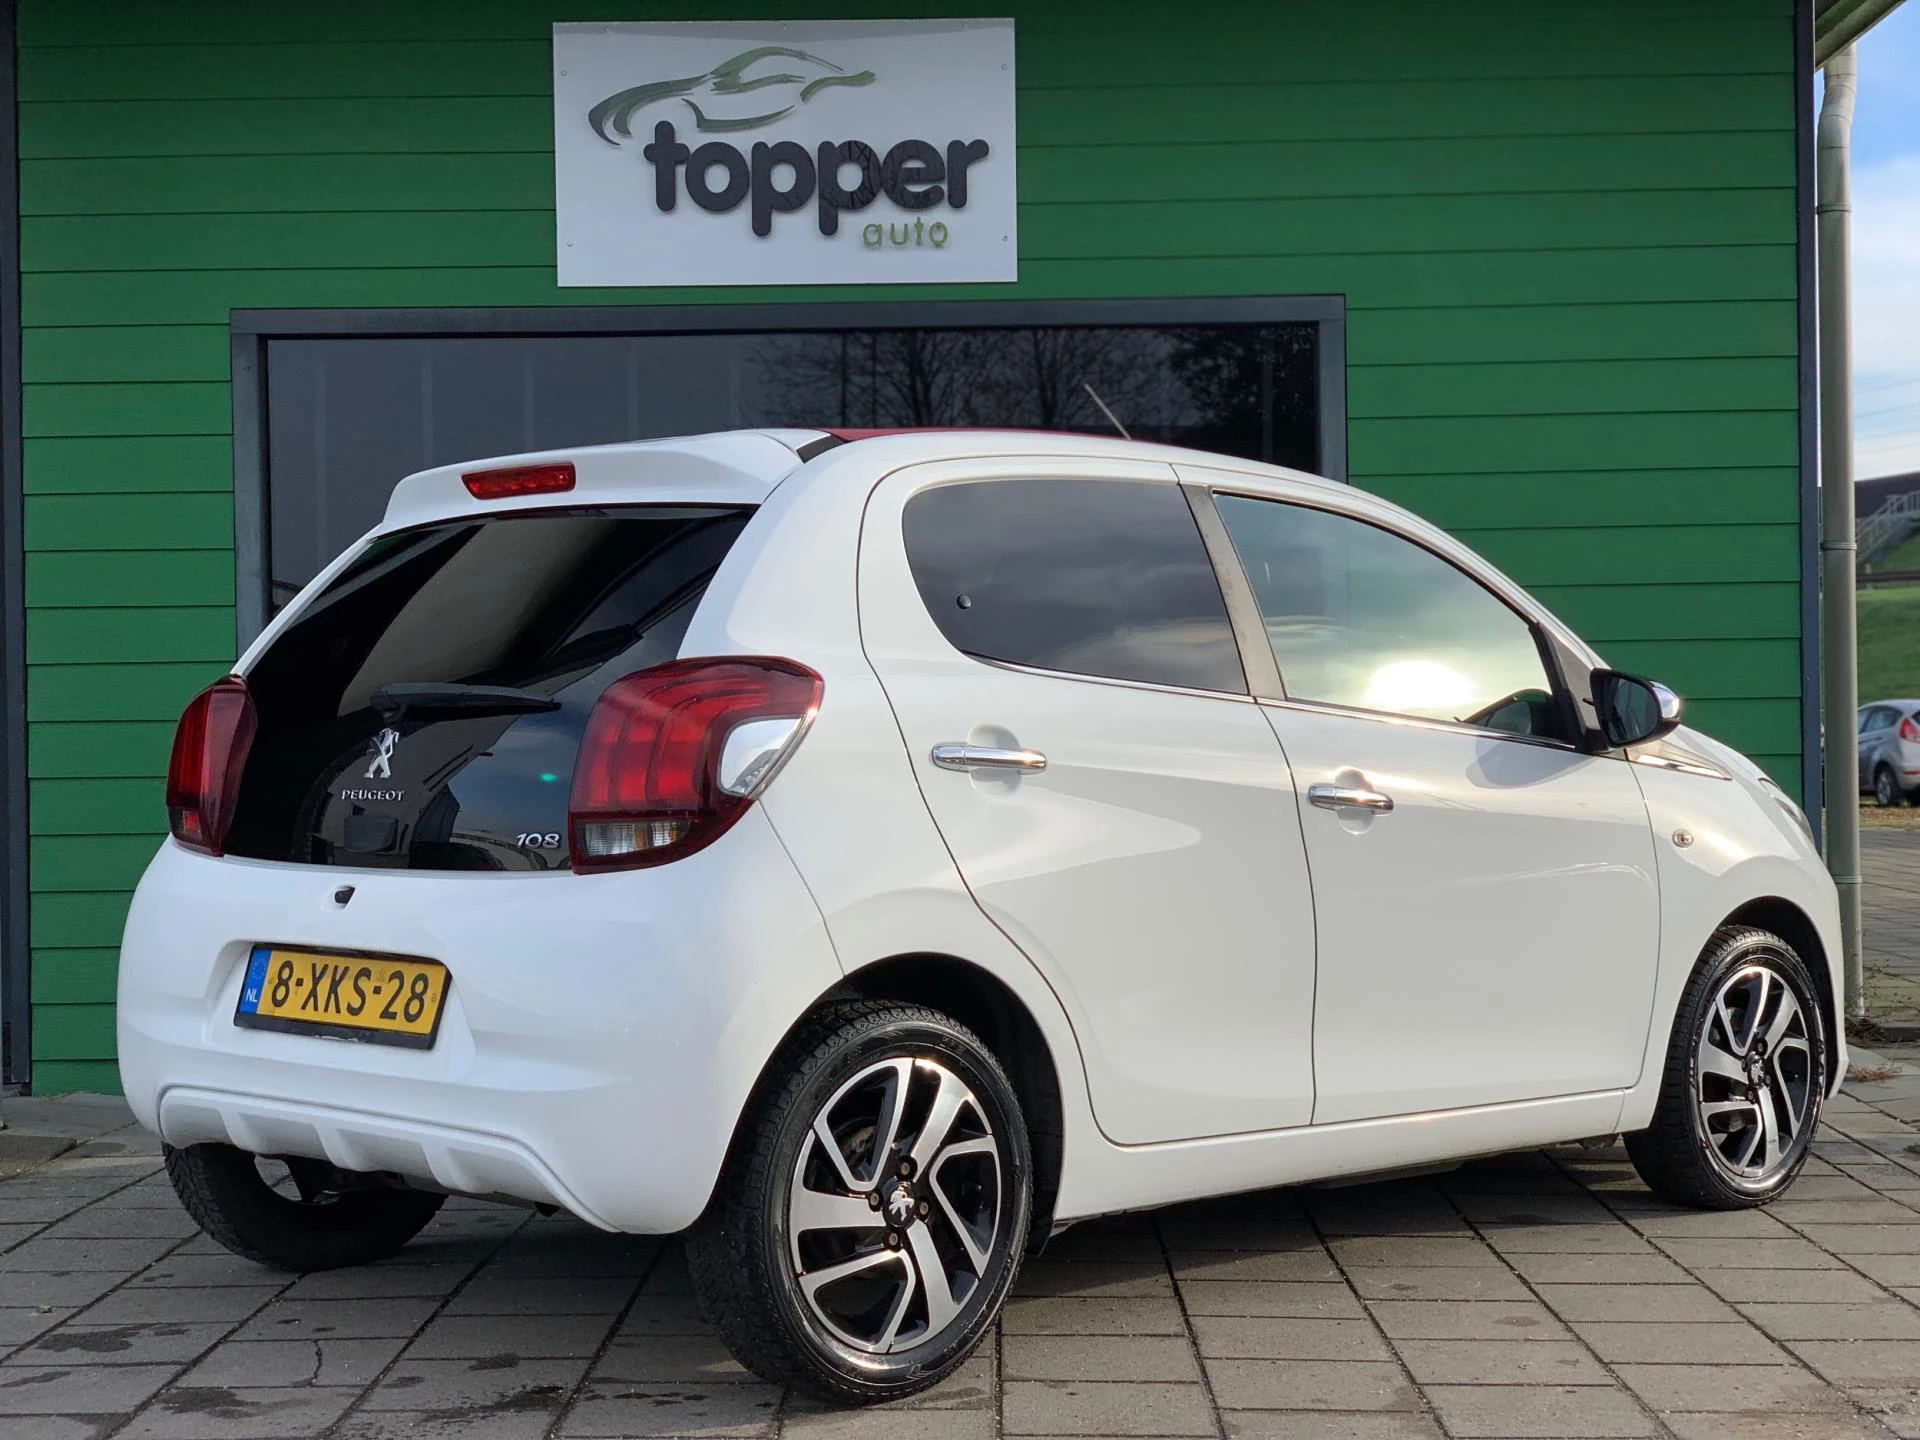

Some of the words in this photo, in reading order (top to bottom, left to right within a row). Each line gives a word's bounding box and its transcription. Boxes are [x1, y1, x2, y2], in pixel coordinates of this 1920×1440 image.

[643, 120, 990, 237] topper
[863, 217, 949, 248] auto
[341, 789, 404, 801] PEUGEOT
[515, 833, 560, 849] 108
[245, 988, 258, 1003] NL
[271, 960, 430, 1023] 8-XKS-28
